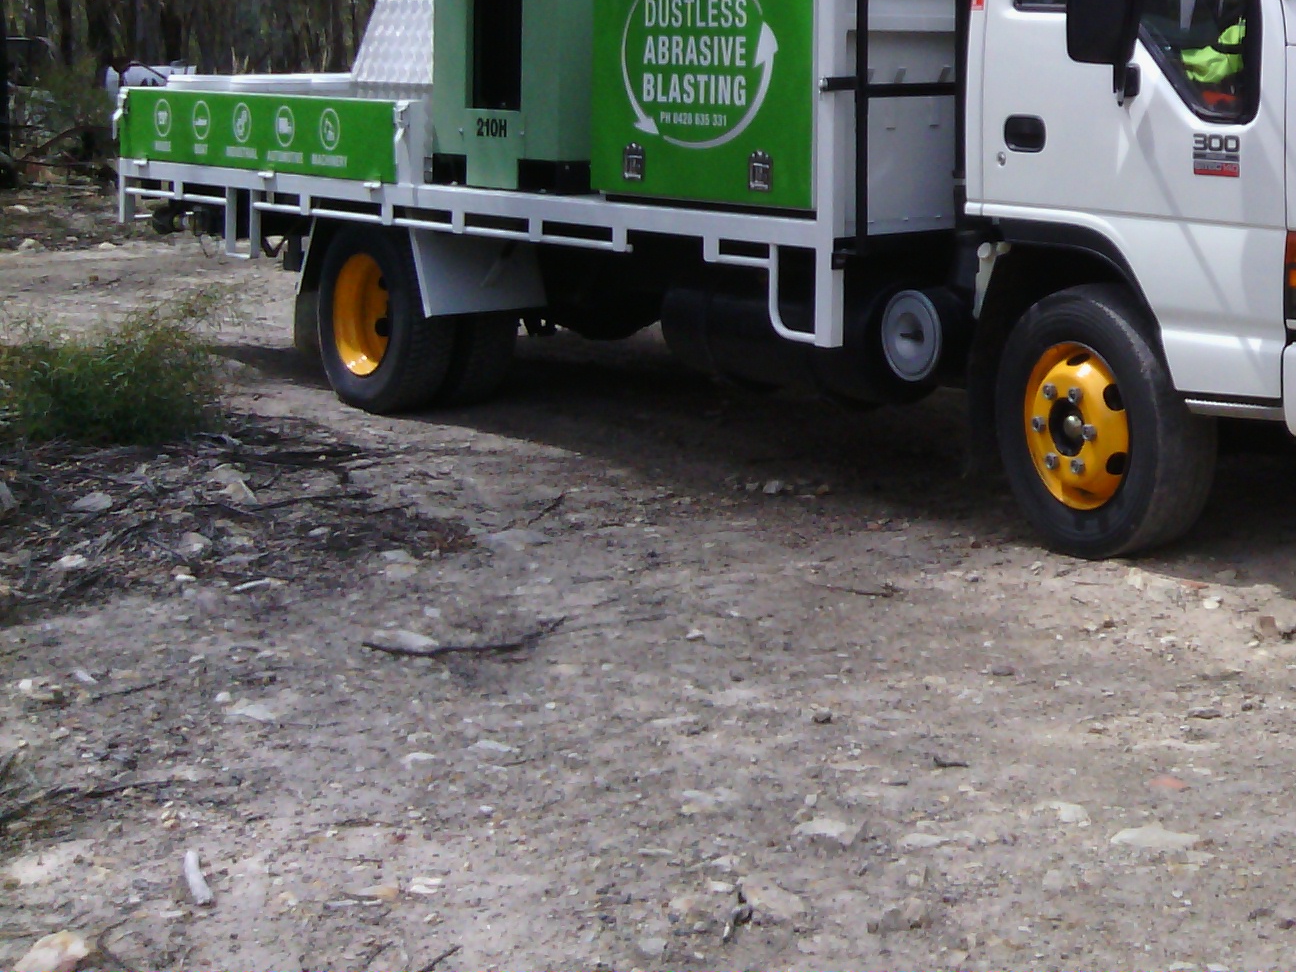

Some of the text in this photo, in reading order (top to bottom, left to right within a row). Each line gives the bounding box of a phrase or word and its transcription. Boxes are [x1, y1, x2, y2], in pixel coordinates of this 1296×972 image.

[643, 36, 747, 66] ABRASIVE
[643, 73, 747, 106] BLASTING
[476, 117, 507, 138] 210H
[660, 111, 671, 124] PH
[1193, 133, 1240, 153] 300
